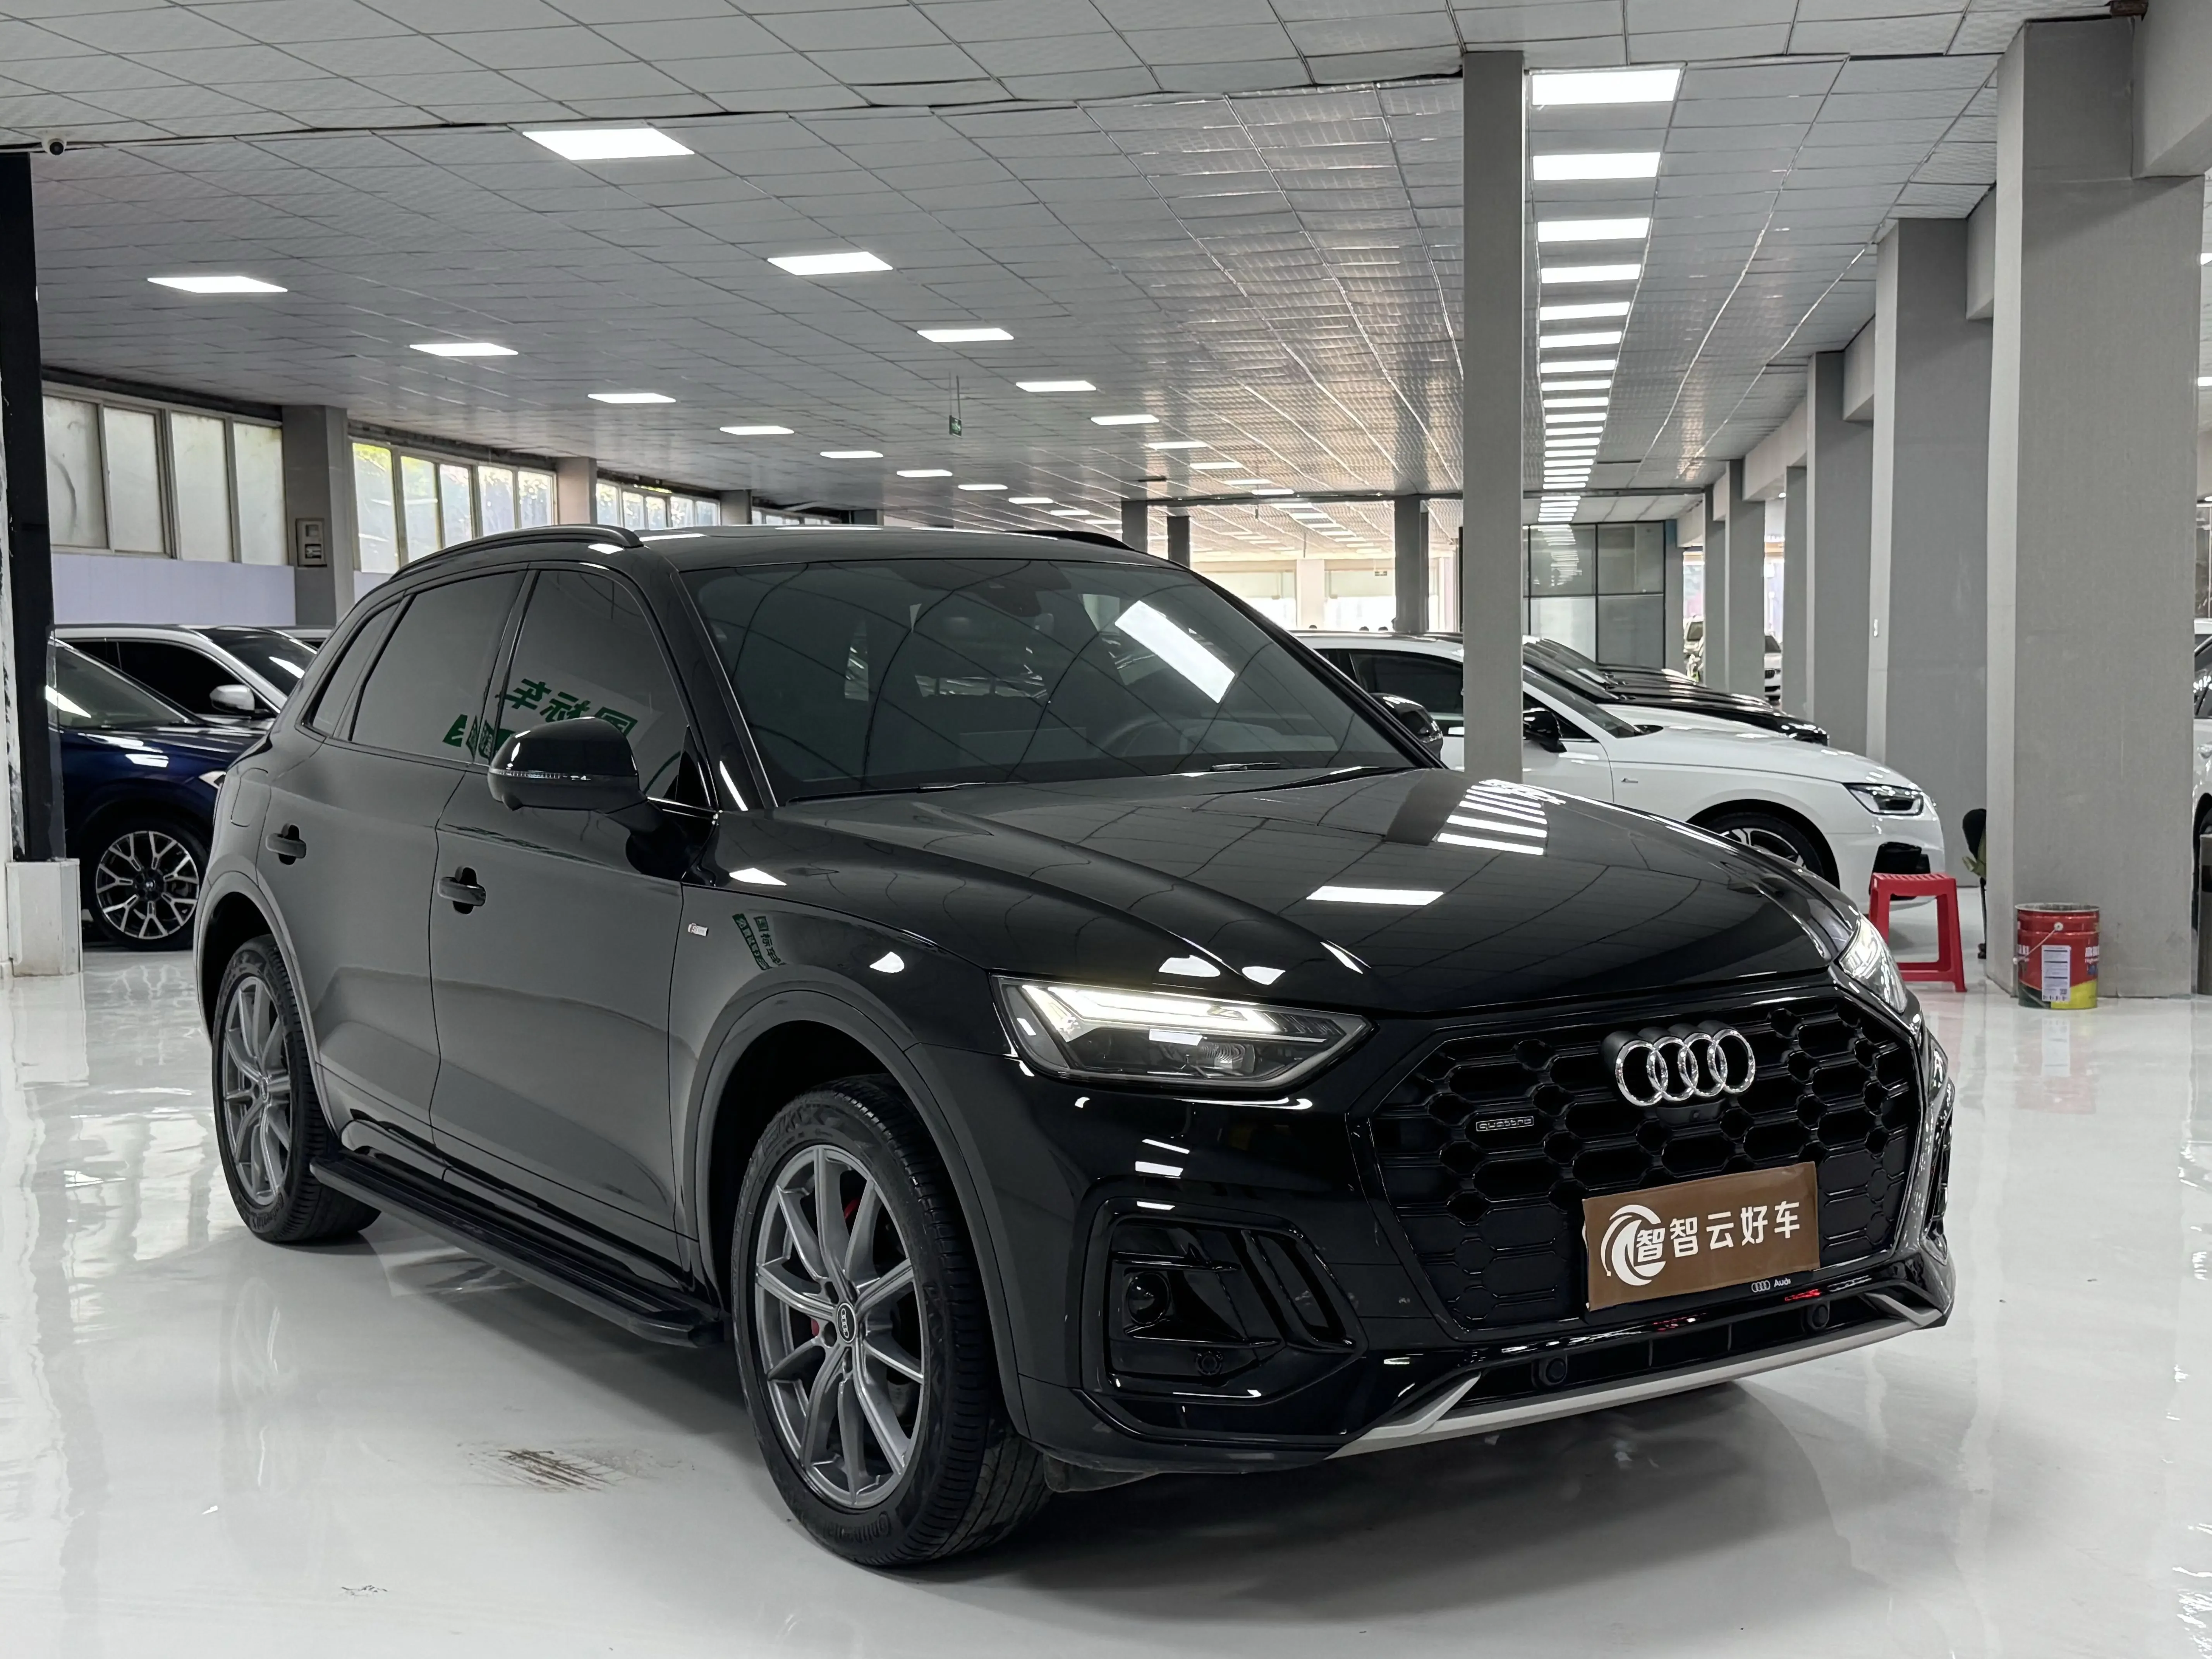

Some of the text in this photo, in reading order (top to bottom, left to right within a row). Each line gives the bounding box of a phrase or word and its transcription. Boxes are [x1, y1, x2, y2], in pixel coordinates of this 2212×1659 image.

[1479, 1118, 1532, 1130] quattro
[1636, 1201, 1800, 1262] 智 智云好车
[1774, 1278, 1791, 1288] Audi
